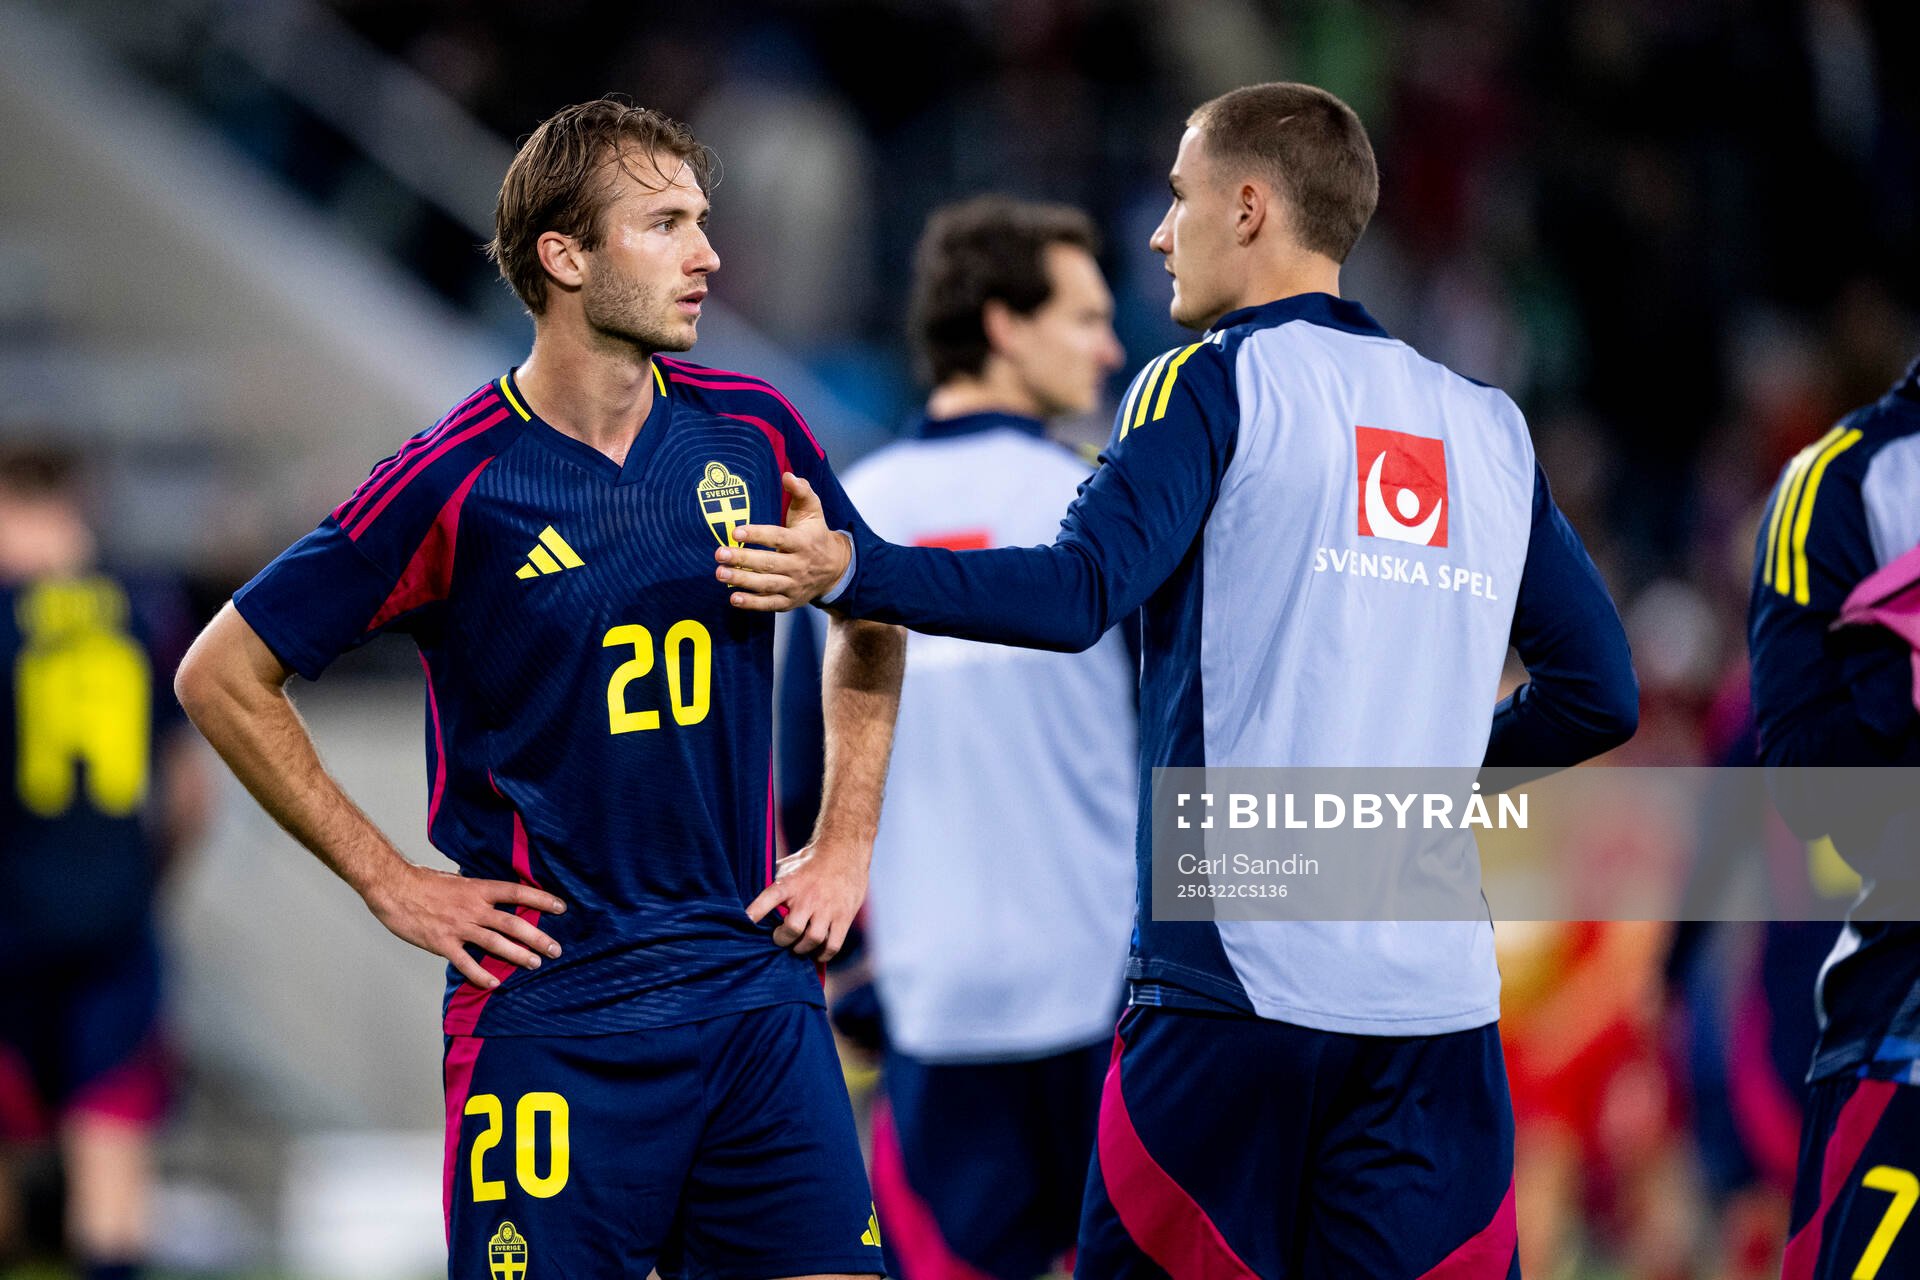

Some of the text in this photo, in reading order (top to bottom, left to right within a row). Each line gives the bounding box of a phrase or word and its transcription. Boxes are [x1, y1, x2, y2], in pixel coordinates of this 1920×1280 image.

[705, 487, 740, 499] SVERIGE
[1314, 547, 1498, 601] SVENSKA SPEL
[602, 619, 712, 735] 20
[464, 1091, 570, 1203] 20
[494, 1244, 522, 1252] SVERIGE
